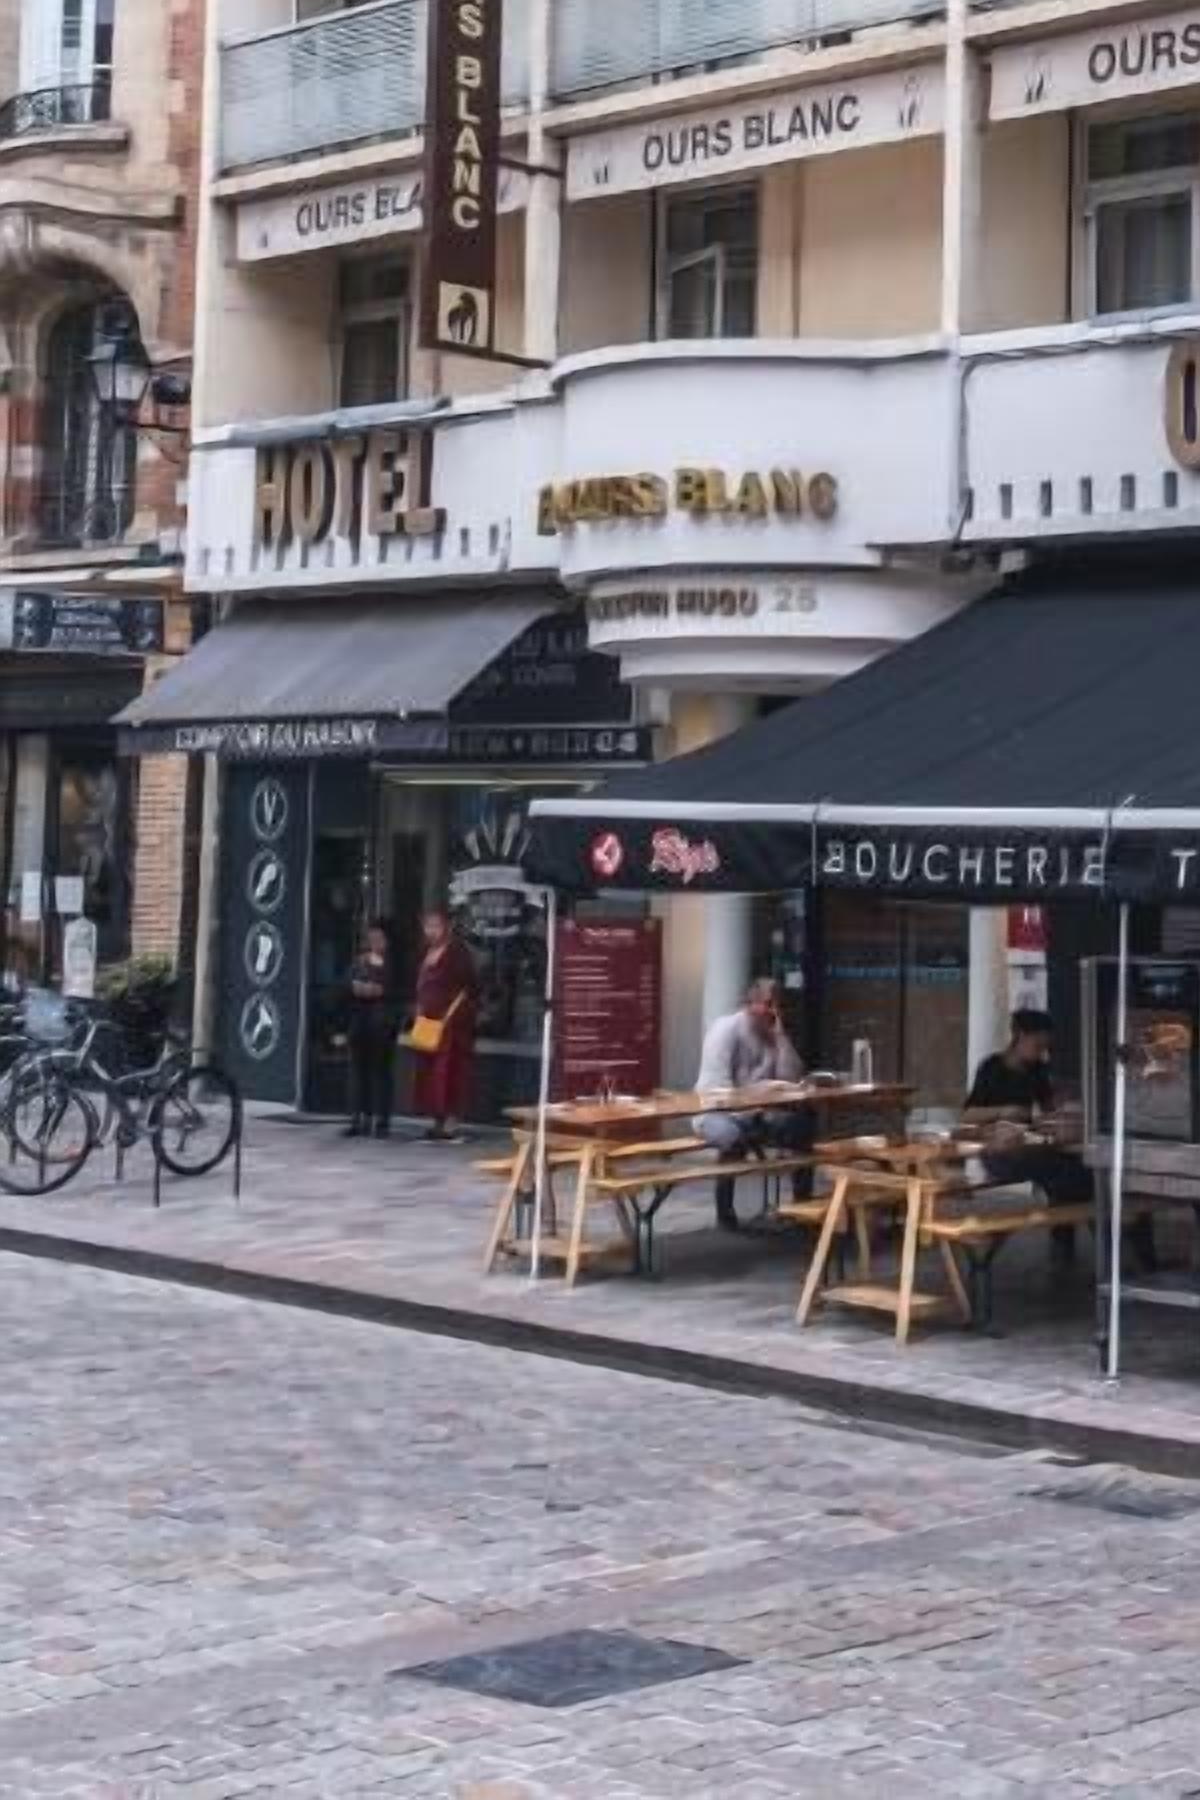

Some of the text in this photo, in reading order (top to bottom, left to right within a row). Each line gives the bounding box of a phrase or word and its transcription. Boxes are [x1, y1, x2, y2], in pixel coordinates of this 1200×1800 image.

[453, 56, 482, 229] BLANC
[643, 94, 860, 169] OURS BLANC
[252, 429, 446, 552] HOTEL
[674, 467, 838, 522] BLANC
